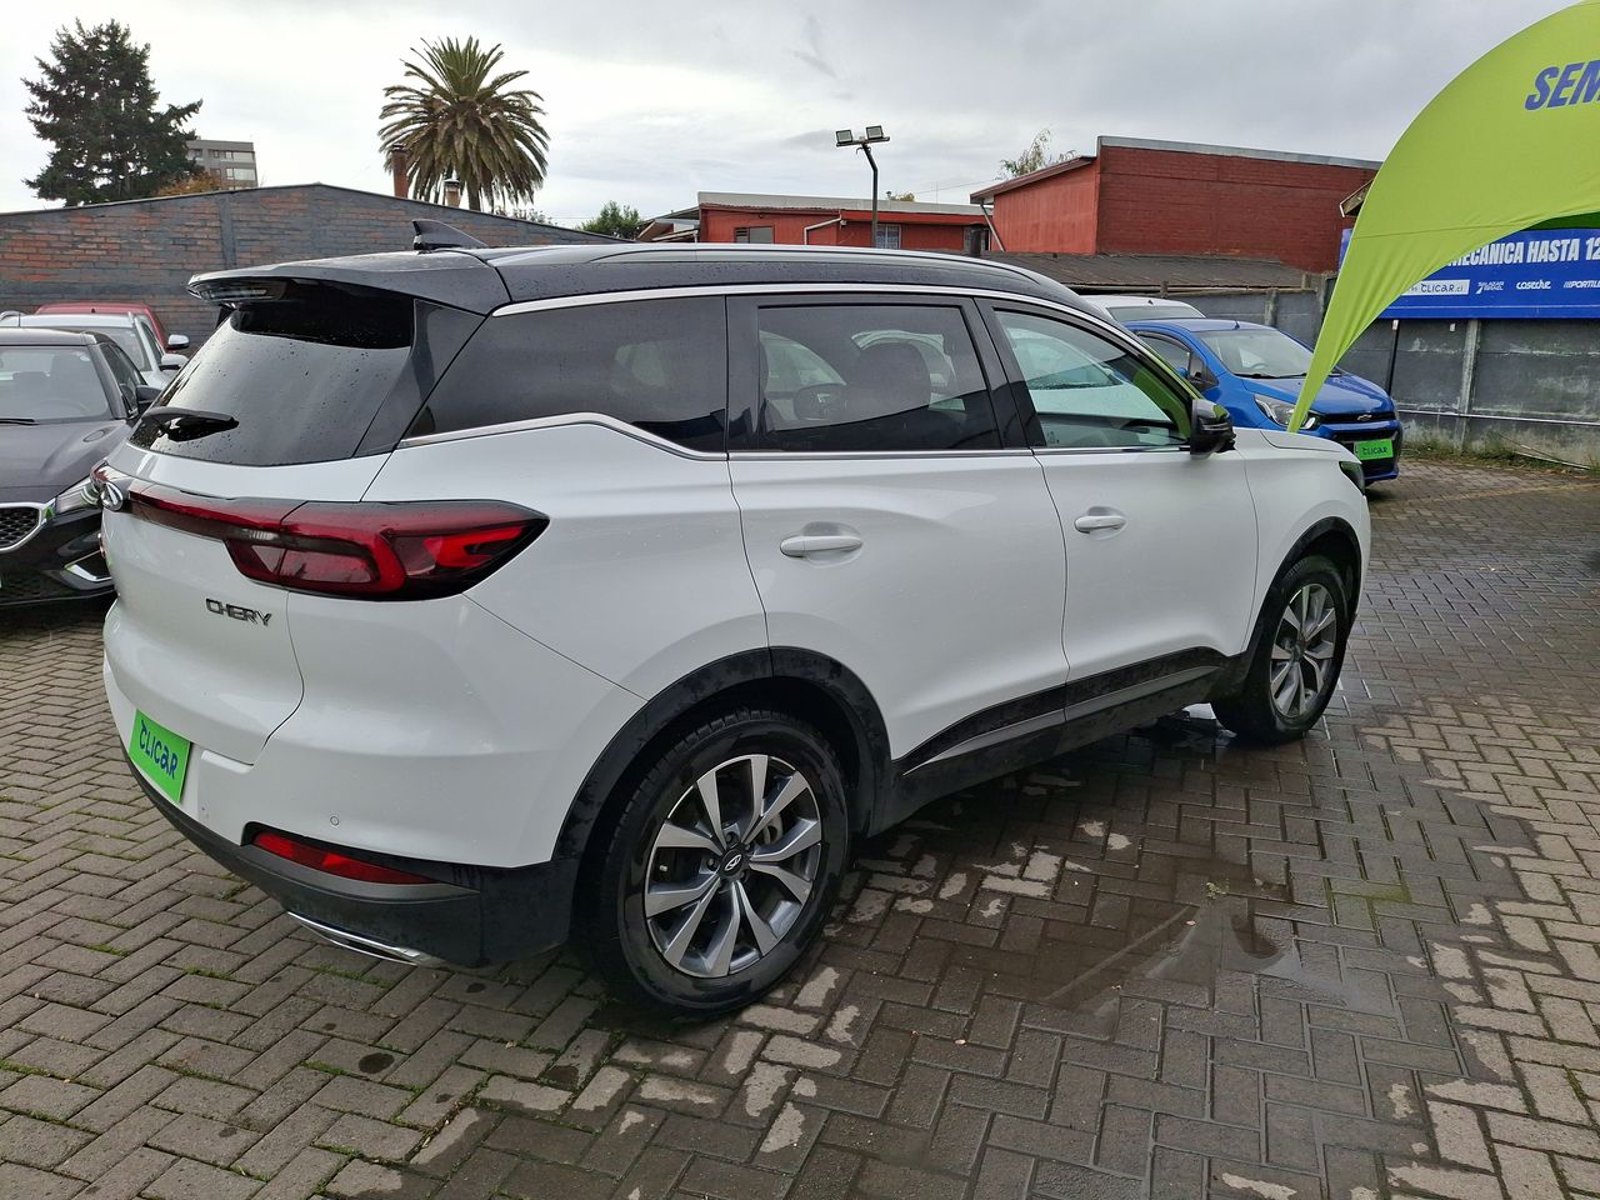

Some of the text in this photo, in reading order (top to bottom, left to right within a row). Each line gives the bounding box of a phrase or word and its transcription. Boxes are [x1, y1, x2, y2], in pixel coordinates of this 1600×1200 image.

[1448, 242, 1525, 266] ECANICA
[1526, 238, 1580, 263] HASTA
[206, 599, 272, 626] CHERY
